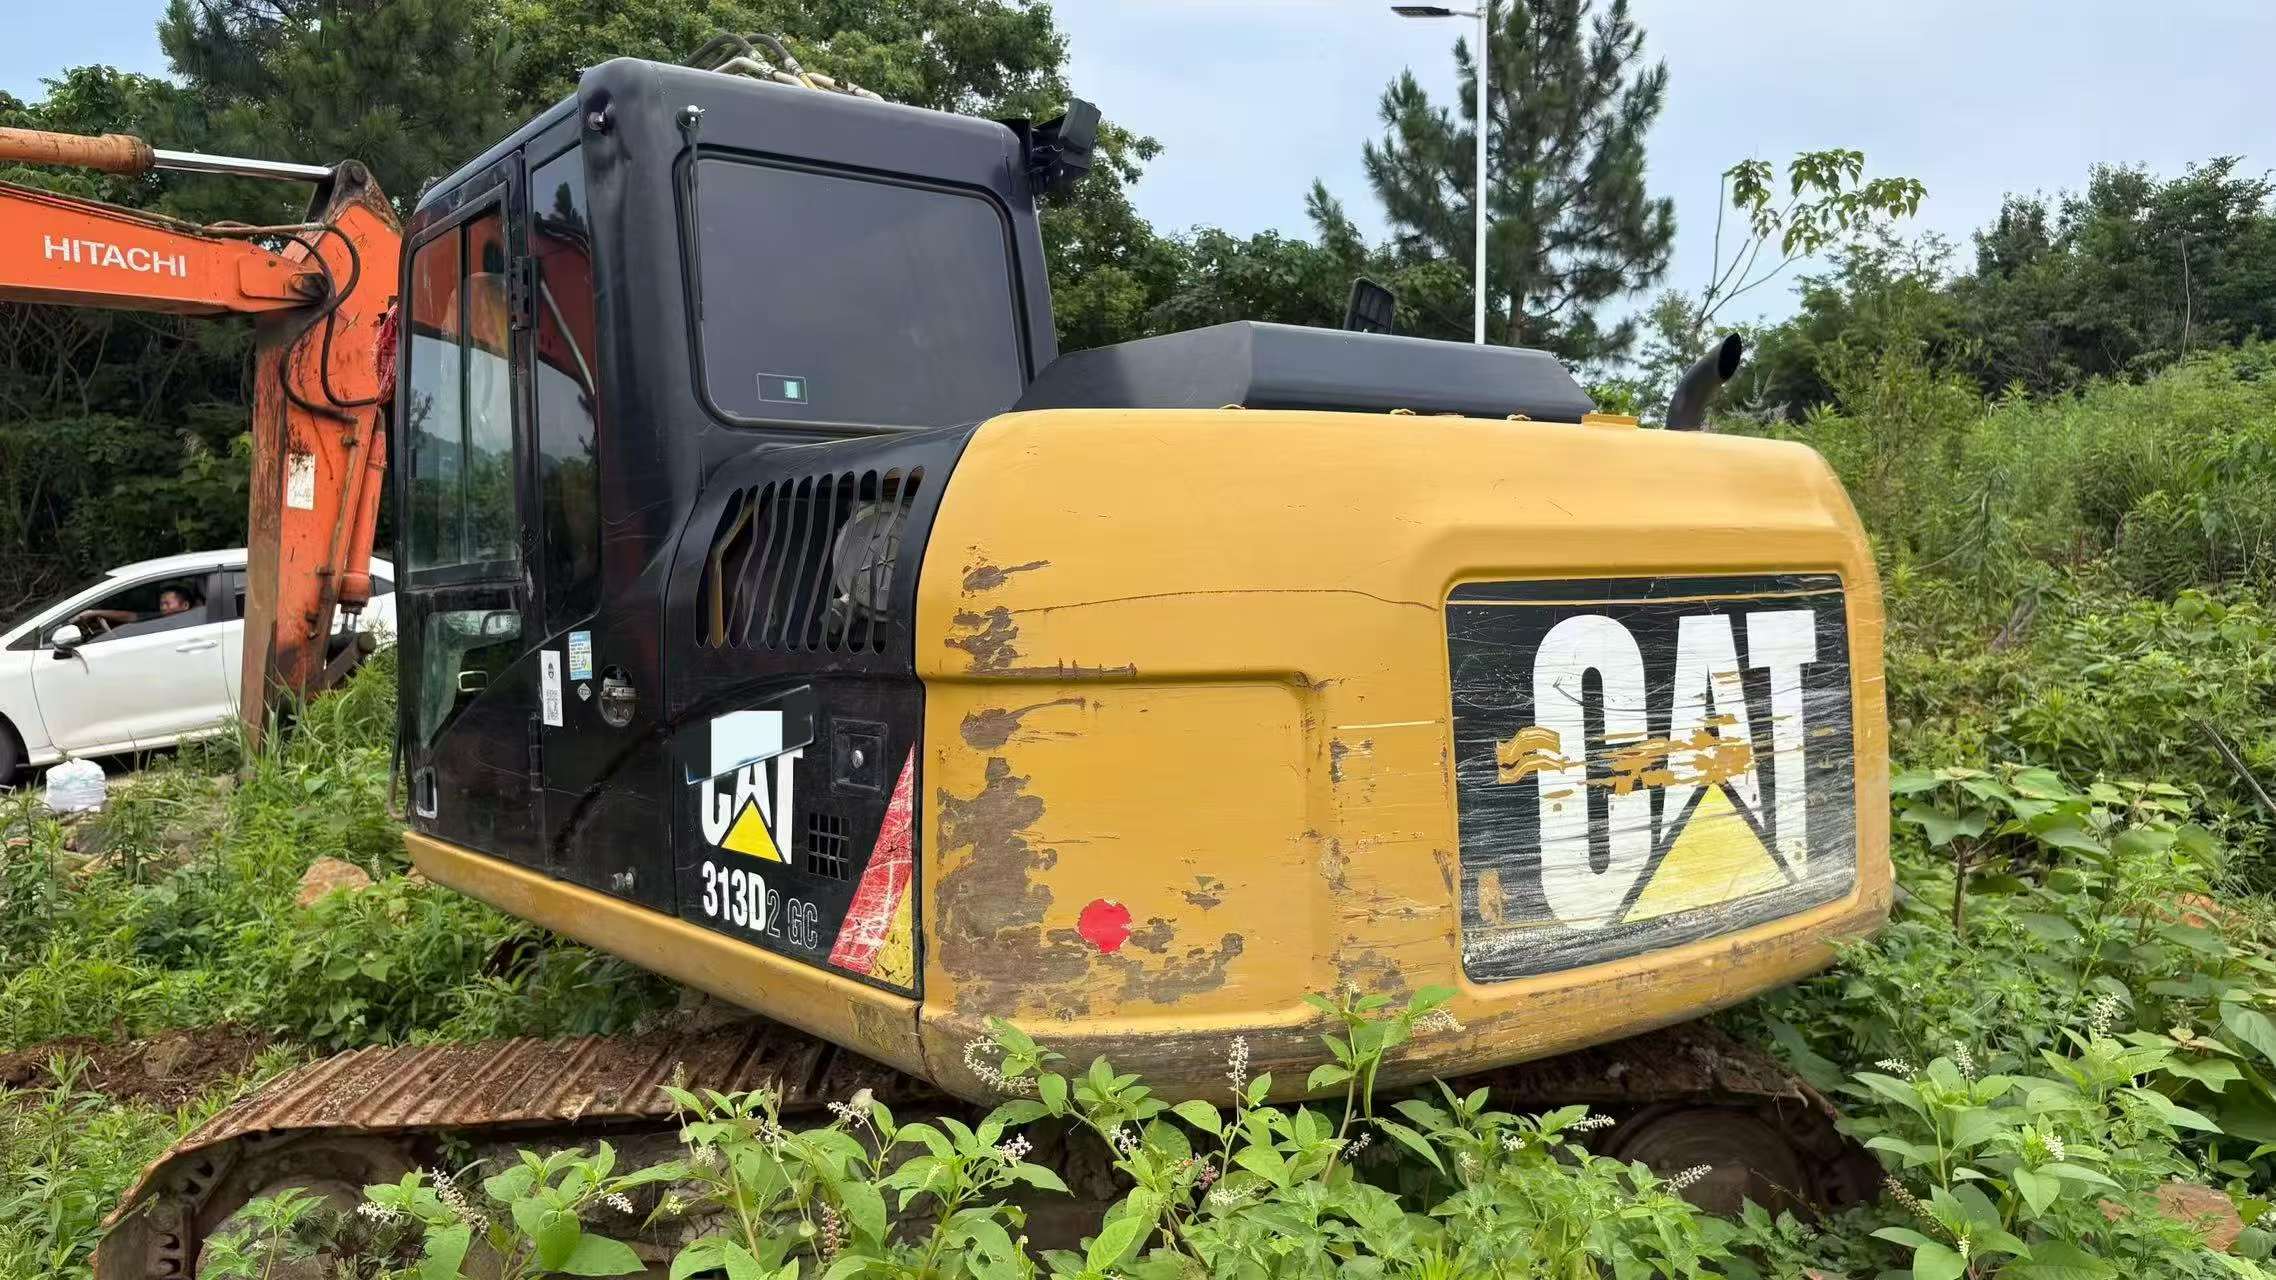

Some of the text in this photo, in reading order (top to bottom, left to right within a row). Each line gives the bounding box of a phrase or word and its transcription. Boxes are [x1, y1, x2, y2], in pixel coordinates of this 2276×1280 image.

[43, 235, 187, 277] HITACHI
[701, 748, 804, 864] CAT
[1532, 609, 1817, 930] CAT
[787, 897, 818, 950] GC
